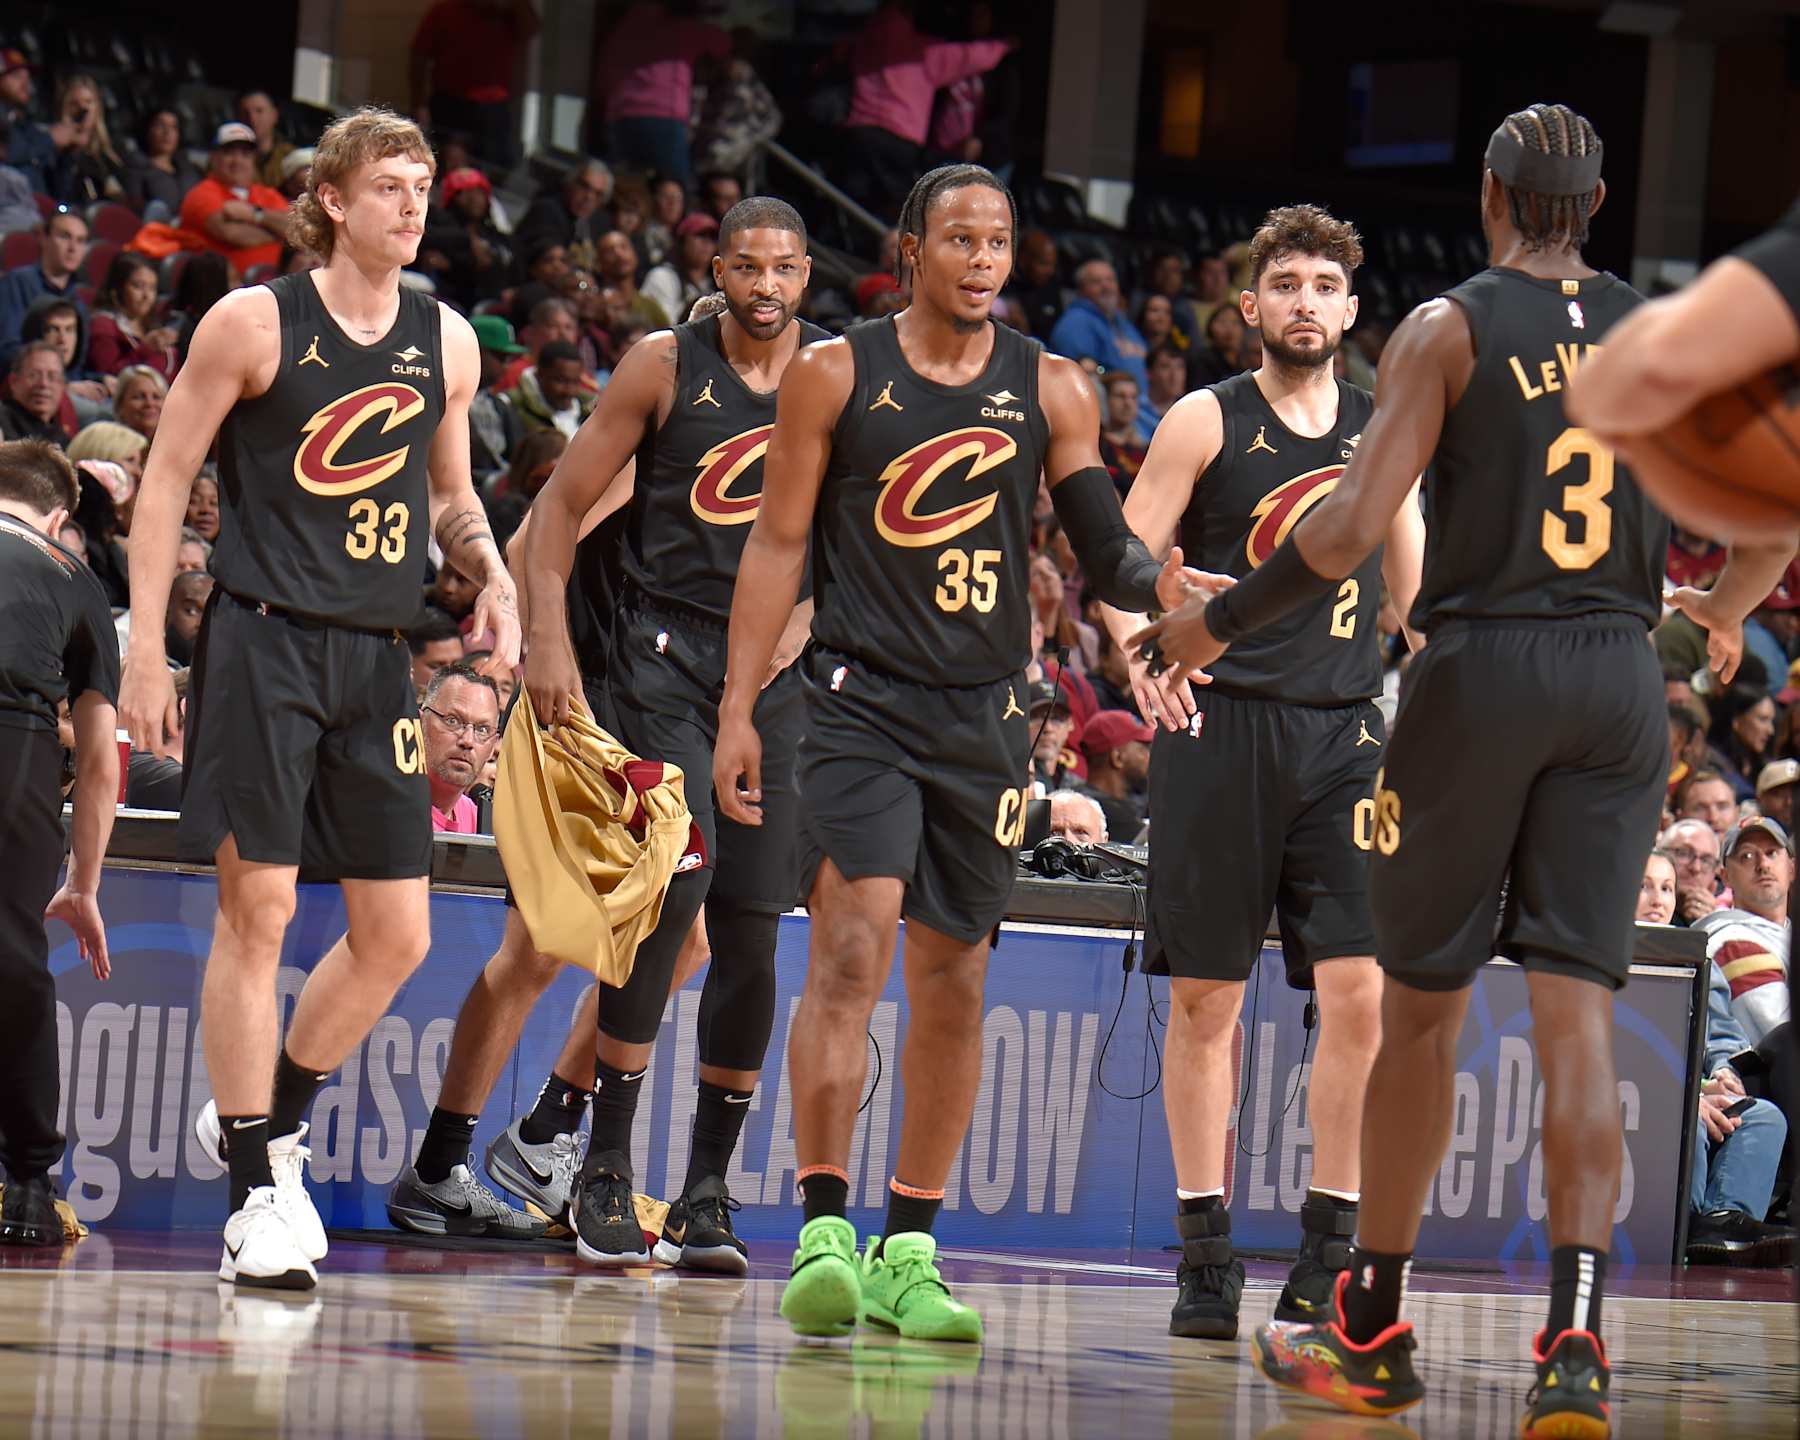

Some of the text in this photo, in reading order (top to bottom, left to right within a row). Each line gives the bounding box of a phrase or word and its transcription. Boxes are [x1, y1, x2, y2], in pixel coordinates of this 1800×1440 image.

[391, 363, 430, 378] CLIFFS
[293, 381, 426, 497] C
[980, 407, 1025, 422] CLIFFS
[873, 426, 1018, 548] C
[1541, 427, 1615, 570] 3
[345, 498, 410, 564] 33
[935, 548, 1002, 613] 35
[1329, 578, 1360, 640] 2
